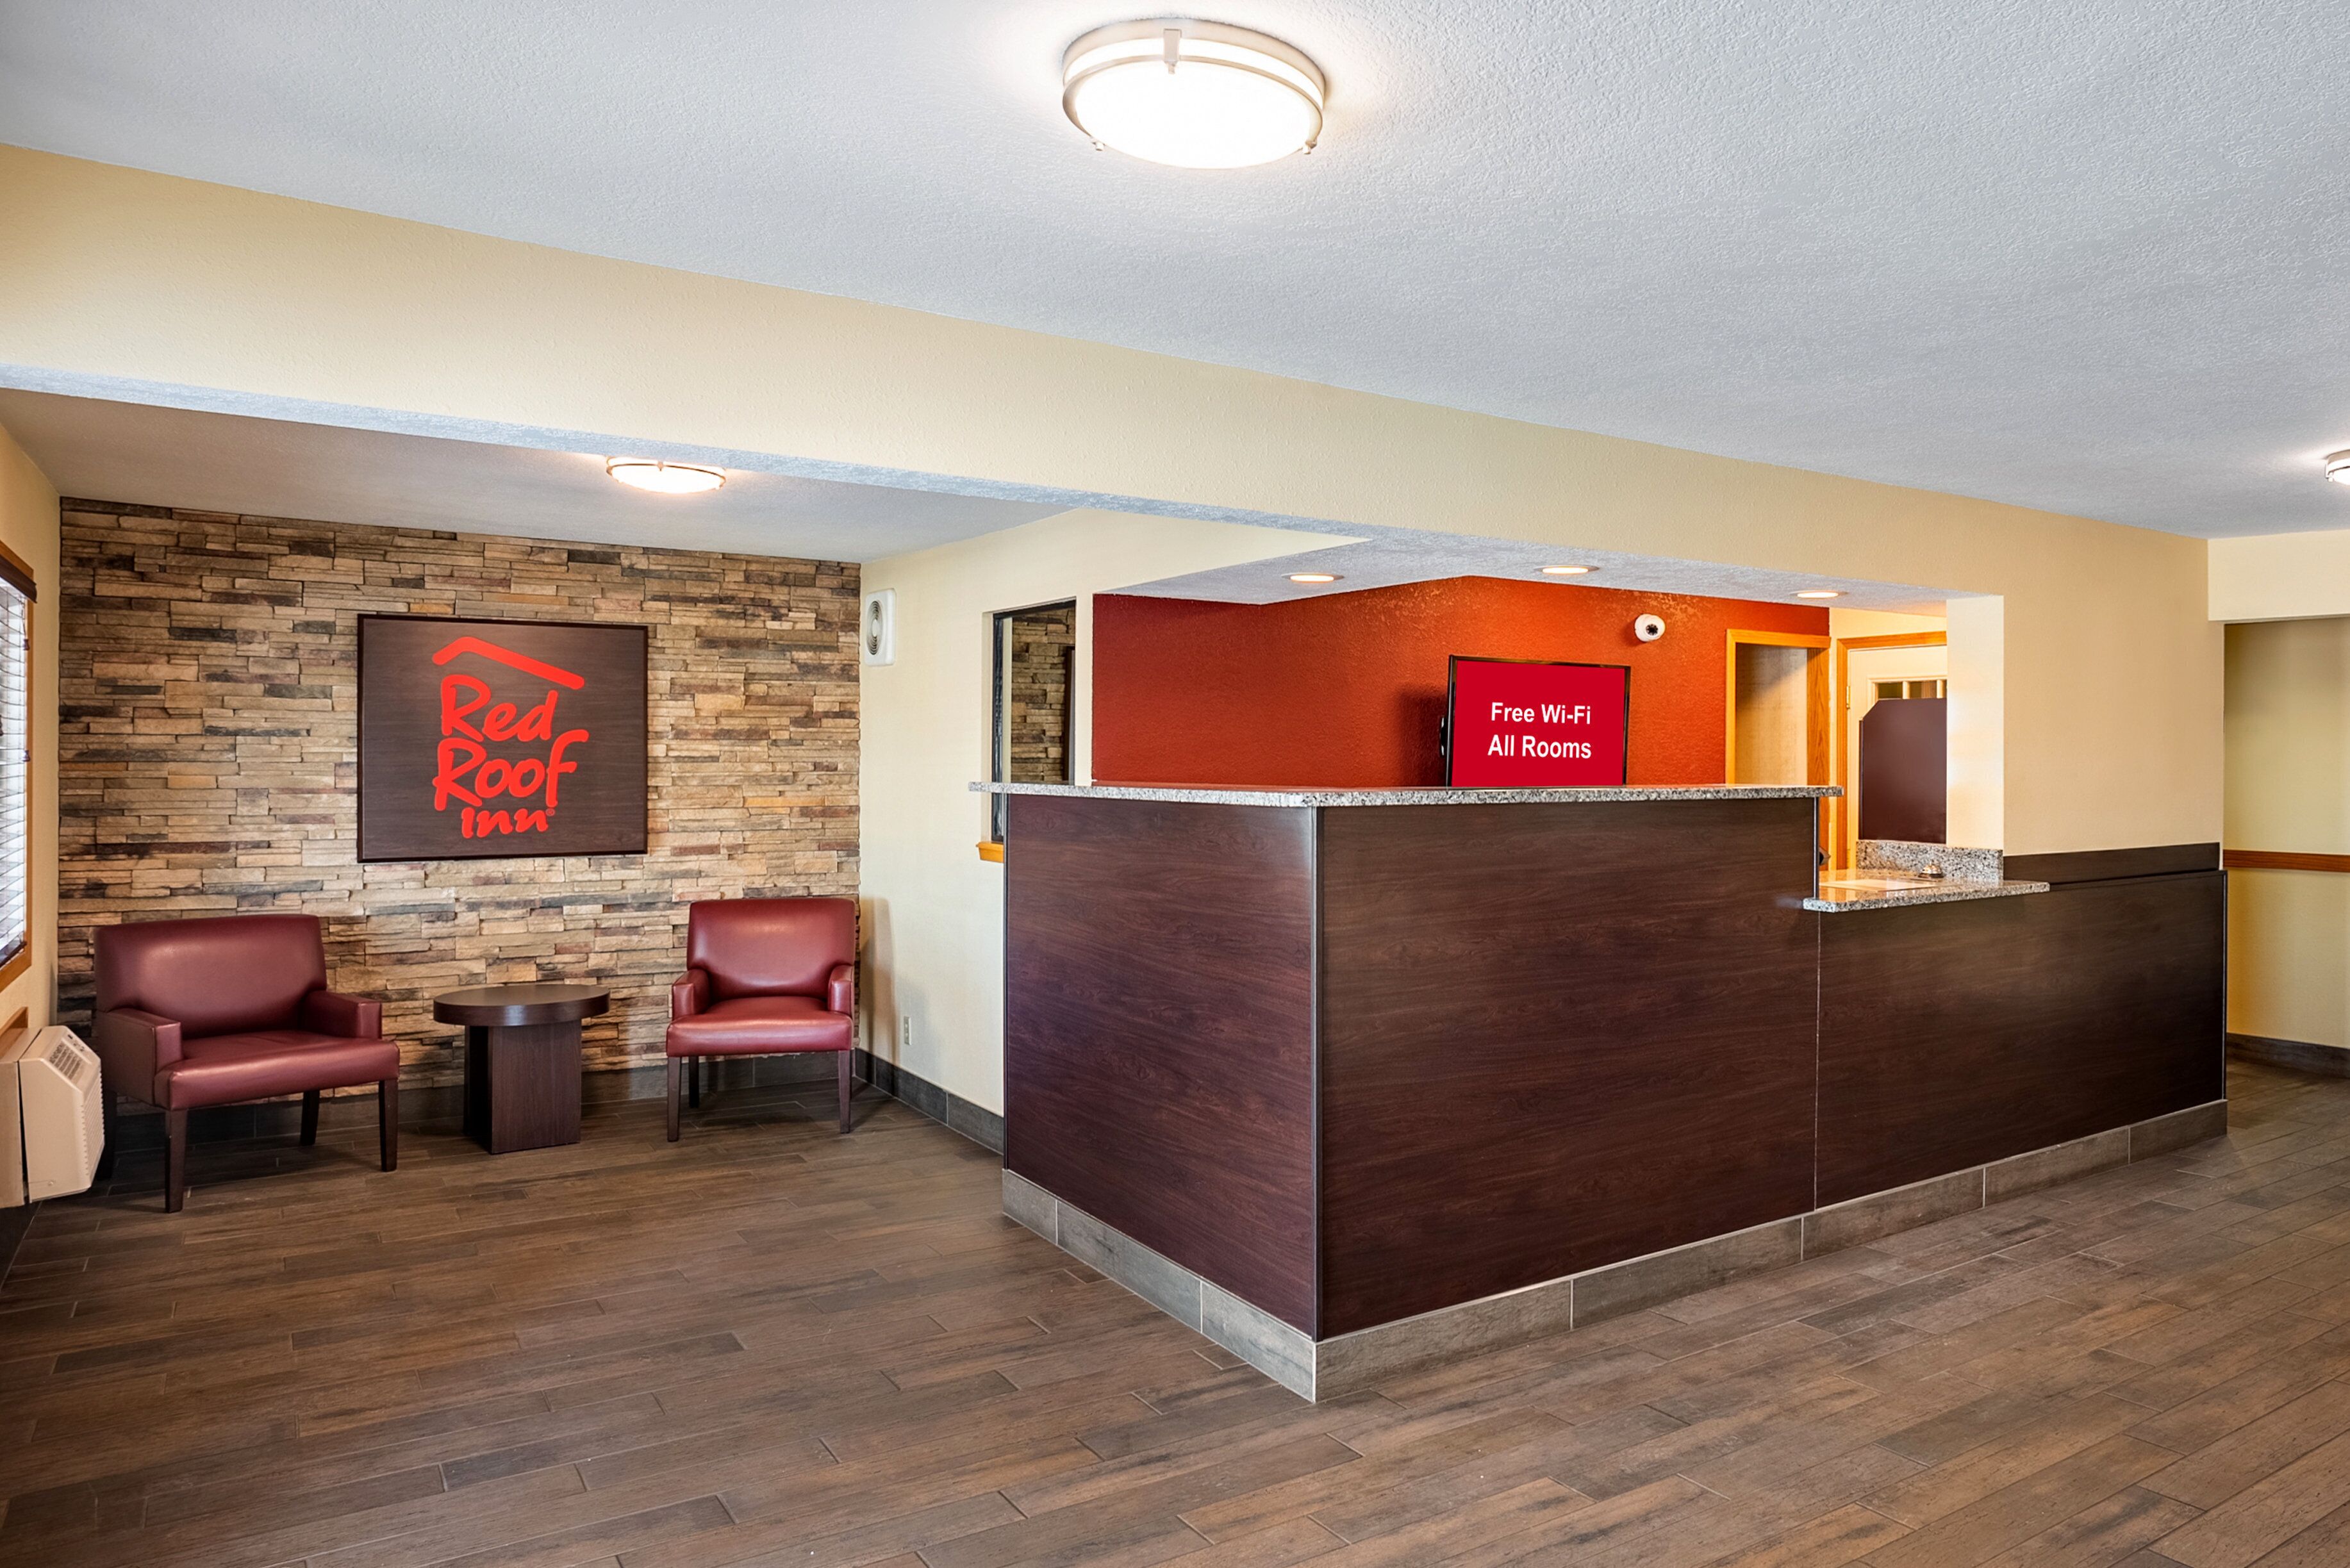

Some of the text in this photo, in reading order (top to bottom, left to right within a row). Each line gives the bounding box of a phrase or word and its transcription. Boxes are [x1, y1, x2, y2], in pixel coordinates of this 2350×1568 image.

[441, 674, 558, 742] Red
[1491, 702, 1591, 725] Free Wi-Fi
[1487, 734, 1592, 759] All Rooms
[433, 729, 589, 811] Roof
